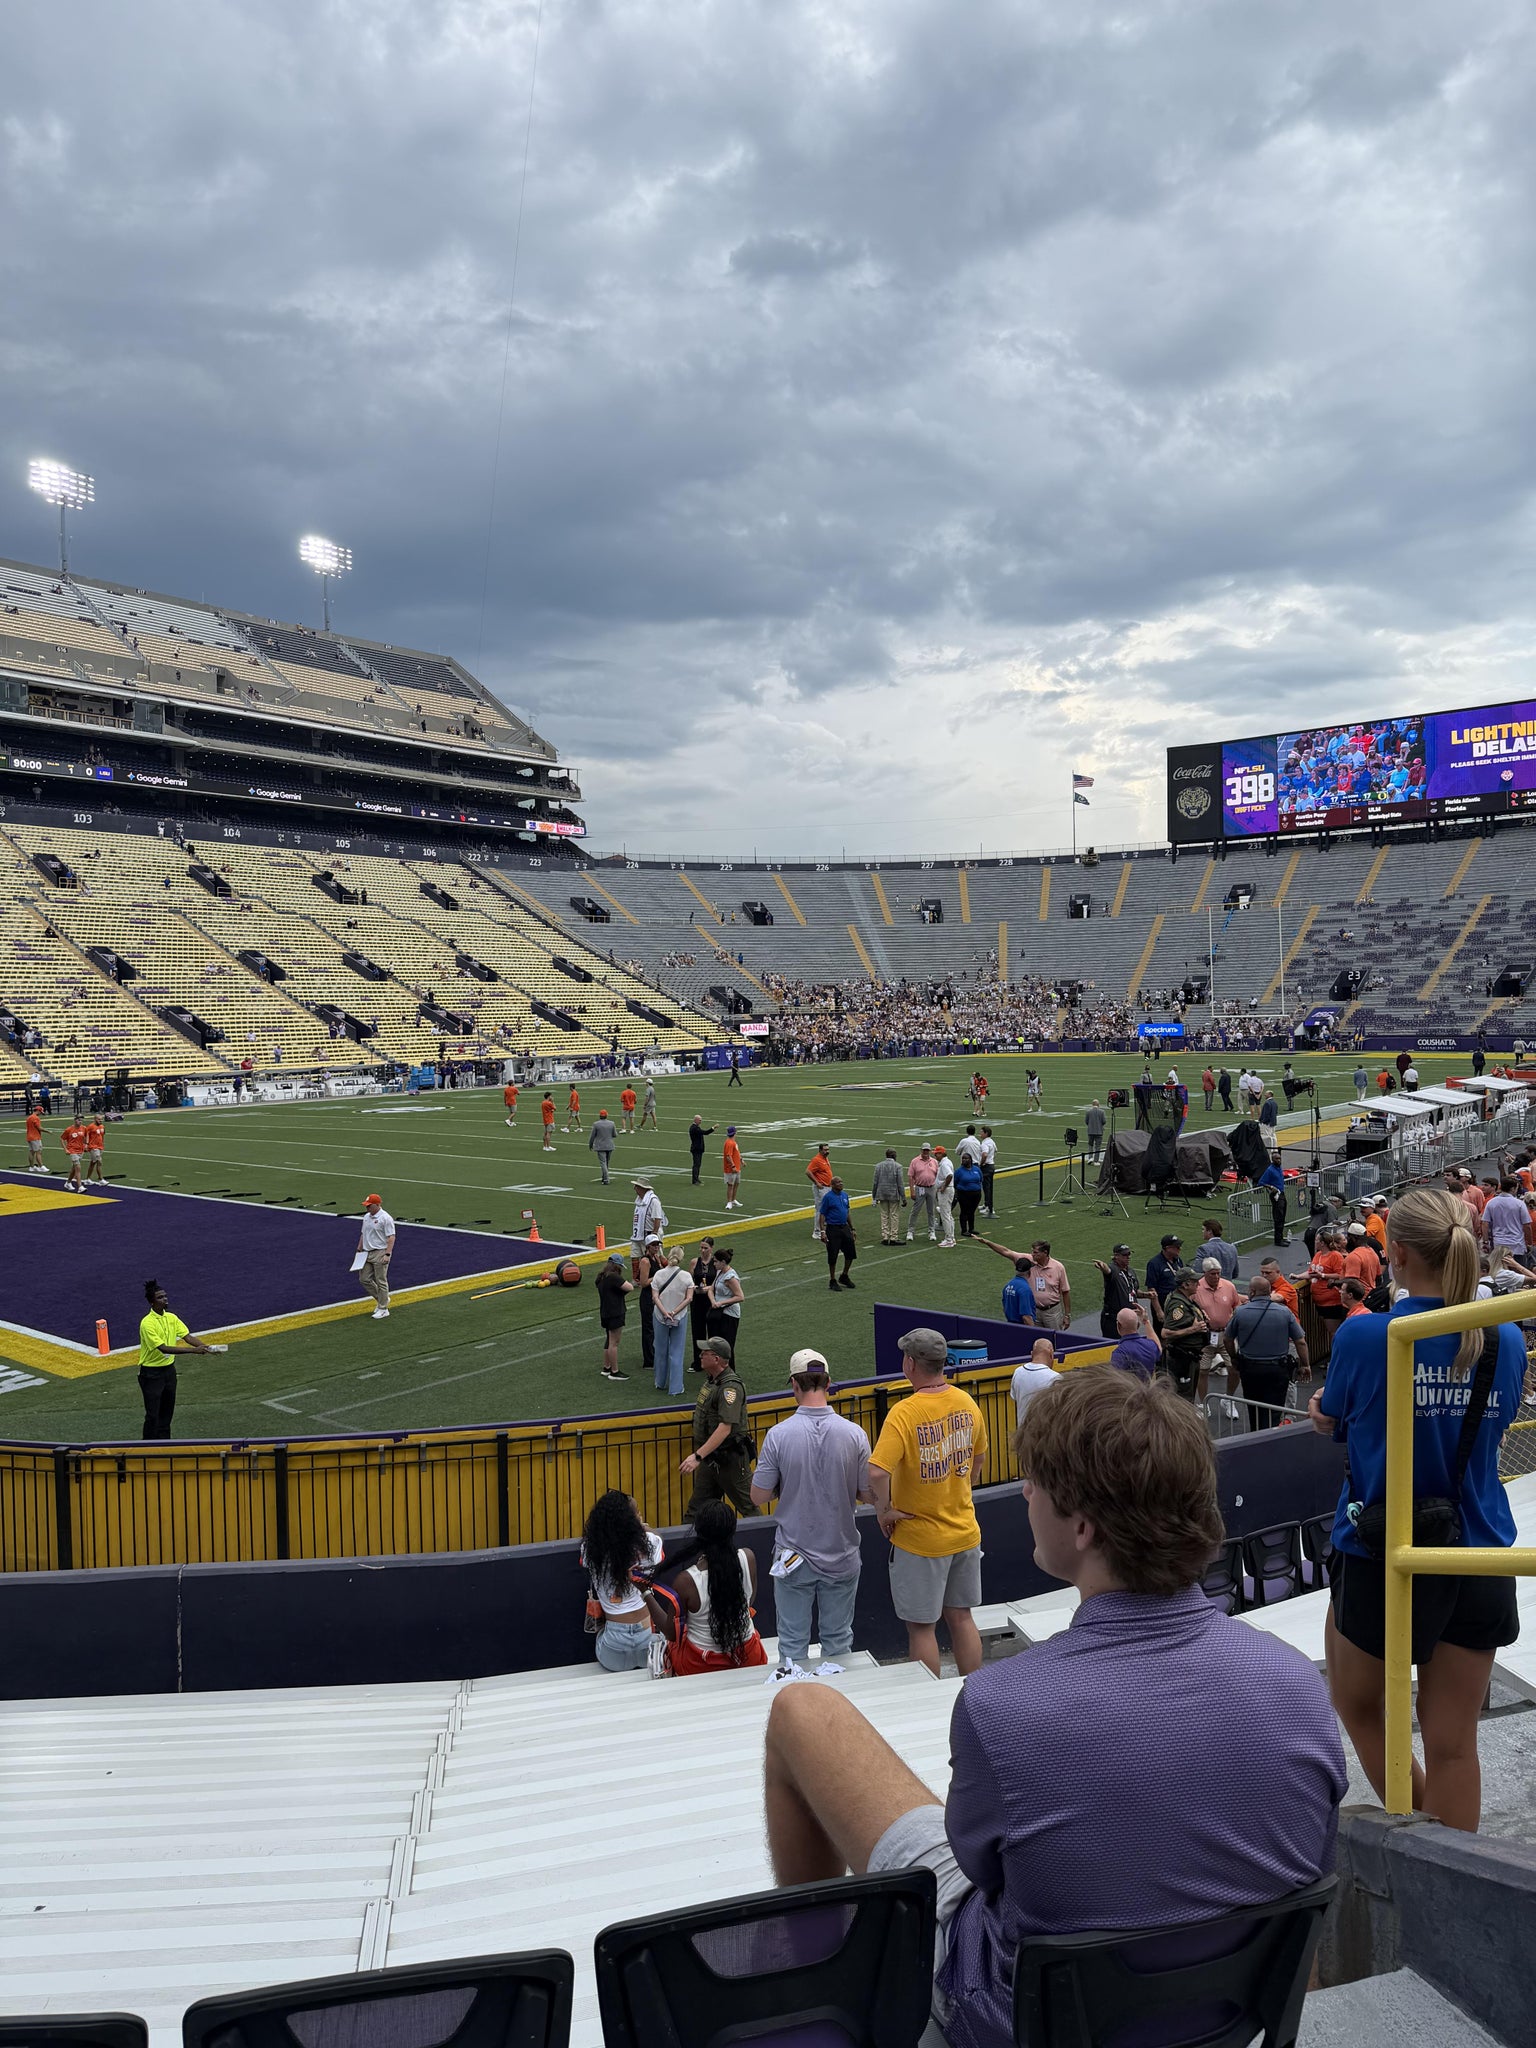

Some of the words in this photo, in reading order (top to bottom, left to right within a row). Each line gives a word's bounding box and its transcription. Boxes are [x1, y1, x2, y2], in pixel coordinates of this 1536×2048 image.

[1451, 720, 1536, 745] LIGHTNI
[13, 758, 42, 770] 90:00
[1450, 760, 1475, 768] PLEASE
[1475, 758, 1491, 766] SEEK
[1493, 755, 1520, 764] SHELTER
[85, 767, 93, 776] 0
[136, 773, 162, 784] Google
[163, 776, 188, 787] Gemini
[256, 788, 279, 798] Google
[279, 791, 302, 800] Gemini
[1226, 772, 1274, 806] 398
[361, 801, 383, 812] Google
[383, 804, 402, 813] Gemini
[73, 813, 92, 824] 103
[223, 827, 241, 838] 104
[1336, 834, 1352, 843] 232
[335, 839, 350, 849] 105
[1248, 842, 1262, 850] 231
[422, 848, 437, 857] 106
[1164, 848, 1180, 856] 20
[468, 853, 481, 862] 222
[529, 858, 541, 867] 223
[626, 861, 639, 869] 224
[720, 863, 733, 871] 225
[1348, 970, 1360, 980] 23
[741, 1023, 767, 1033] MANDA
[1144, 1026, 1175, 1036] Spectrum
[1417, 1038, 1457, 1046] COUSHATTA
[1416, 1386, 1500, 1408] UNIVERAL
[1416, 1408, 1448, 1417] EVENT
[1450, 1408, 1500, 1419] SERCES
[917, 1422, 945, 1446] GEAUX
[947, 1413, 974, 1434] TIGERS
[920, 1445, 940, 1462] 2025
[941, 1428, 973, 1458] NATIONAL
[920, 1447, 973, 1479] CHAMPIONS
